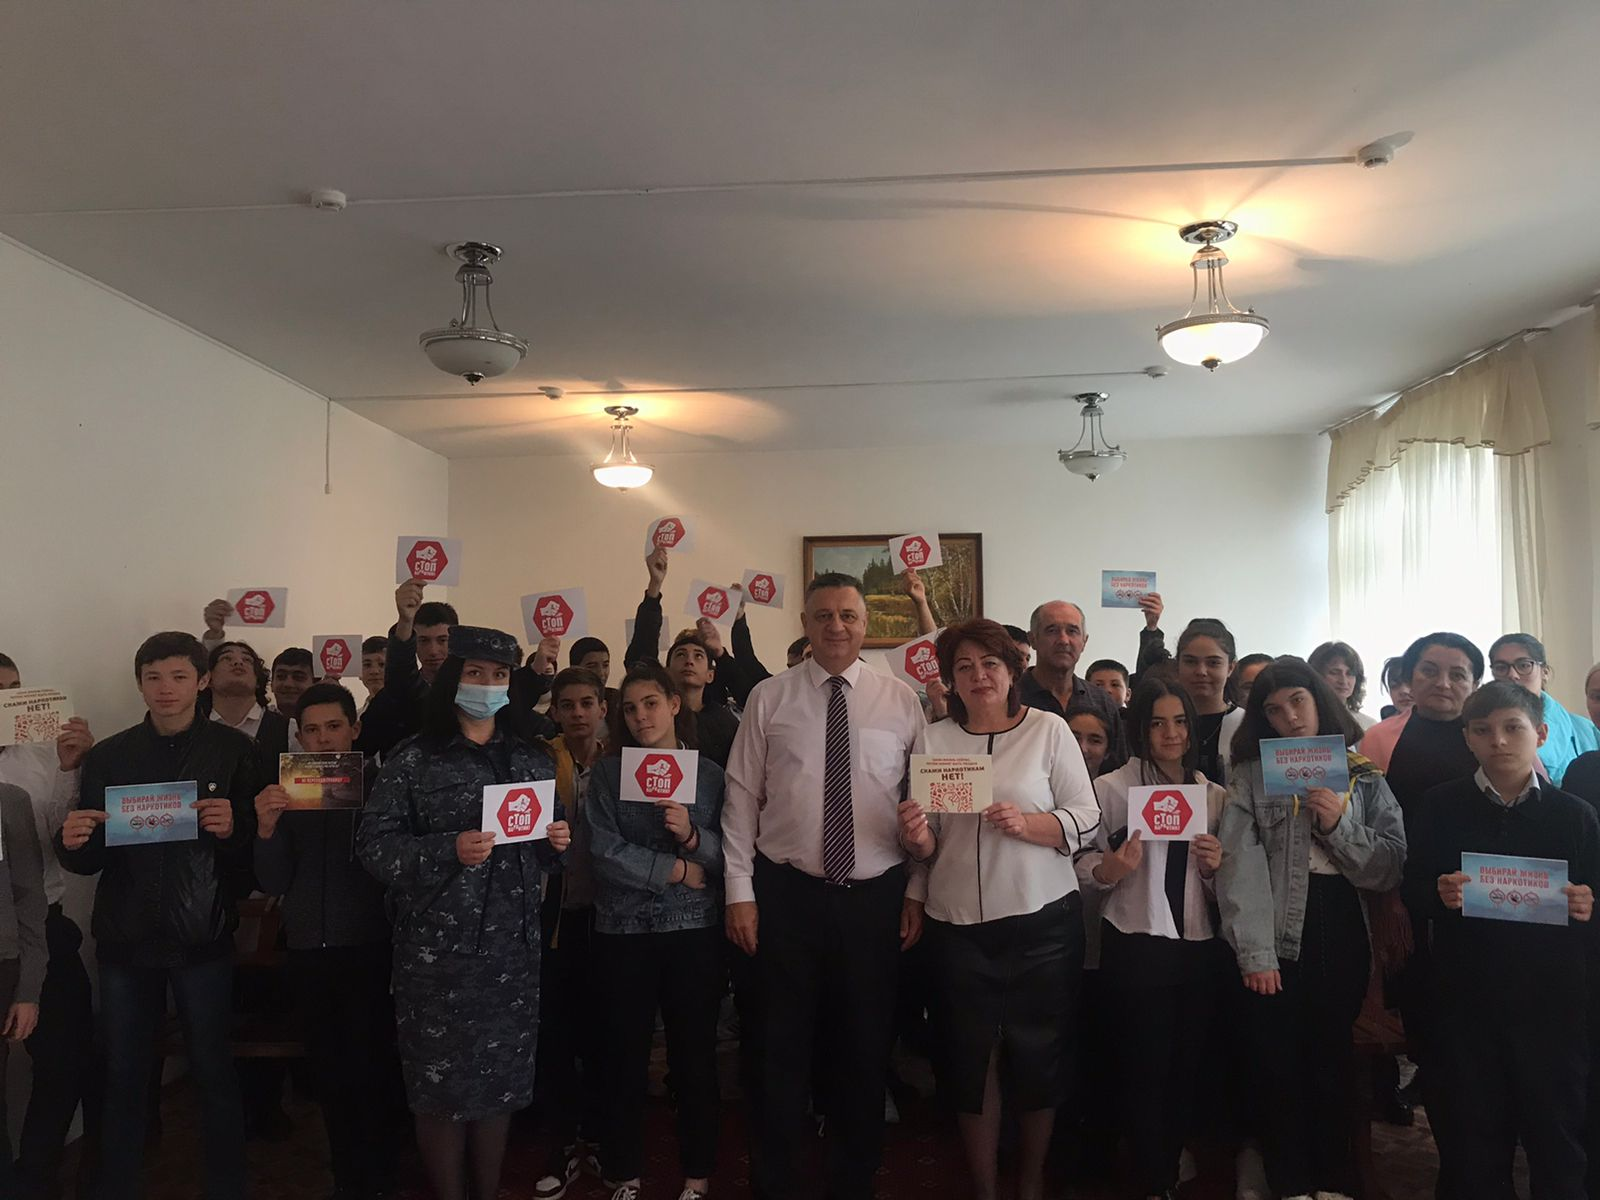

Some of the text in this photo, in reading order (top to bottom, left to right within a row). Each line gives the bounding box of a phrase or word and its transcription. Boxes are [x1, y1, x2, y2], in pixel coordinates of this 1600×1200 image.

[415, 560, 436, 572] СТОП
[542, 616, 563, 628] СТОП
[916, 660, 939, 675] СТОП
[27, 703, 50, 712] НЕТ!
[646, 776, 671, 788] СТОП
[508, 813, 530, 826] СТОП
[1154, 813, 1180, 826] СТОП
[1480, 875, 1550, 888] БЕЗ НАРКОТИКОВ
